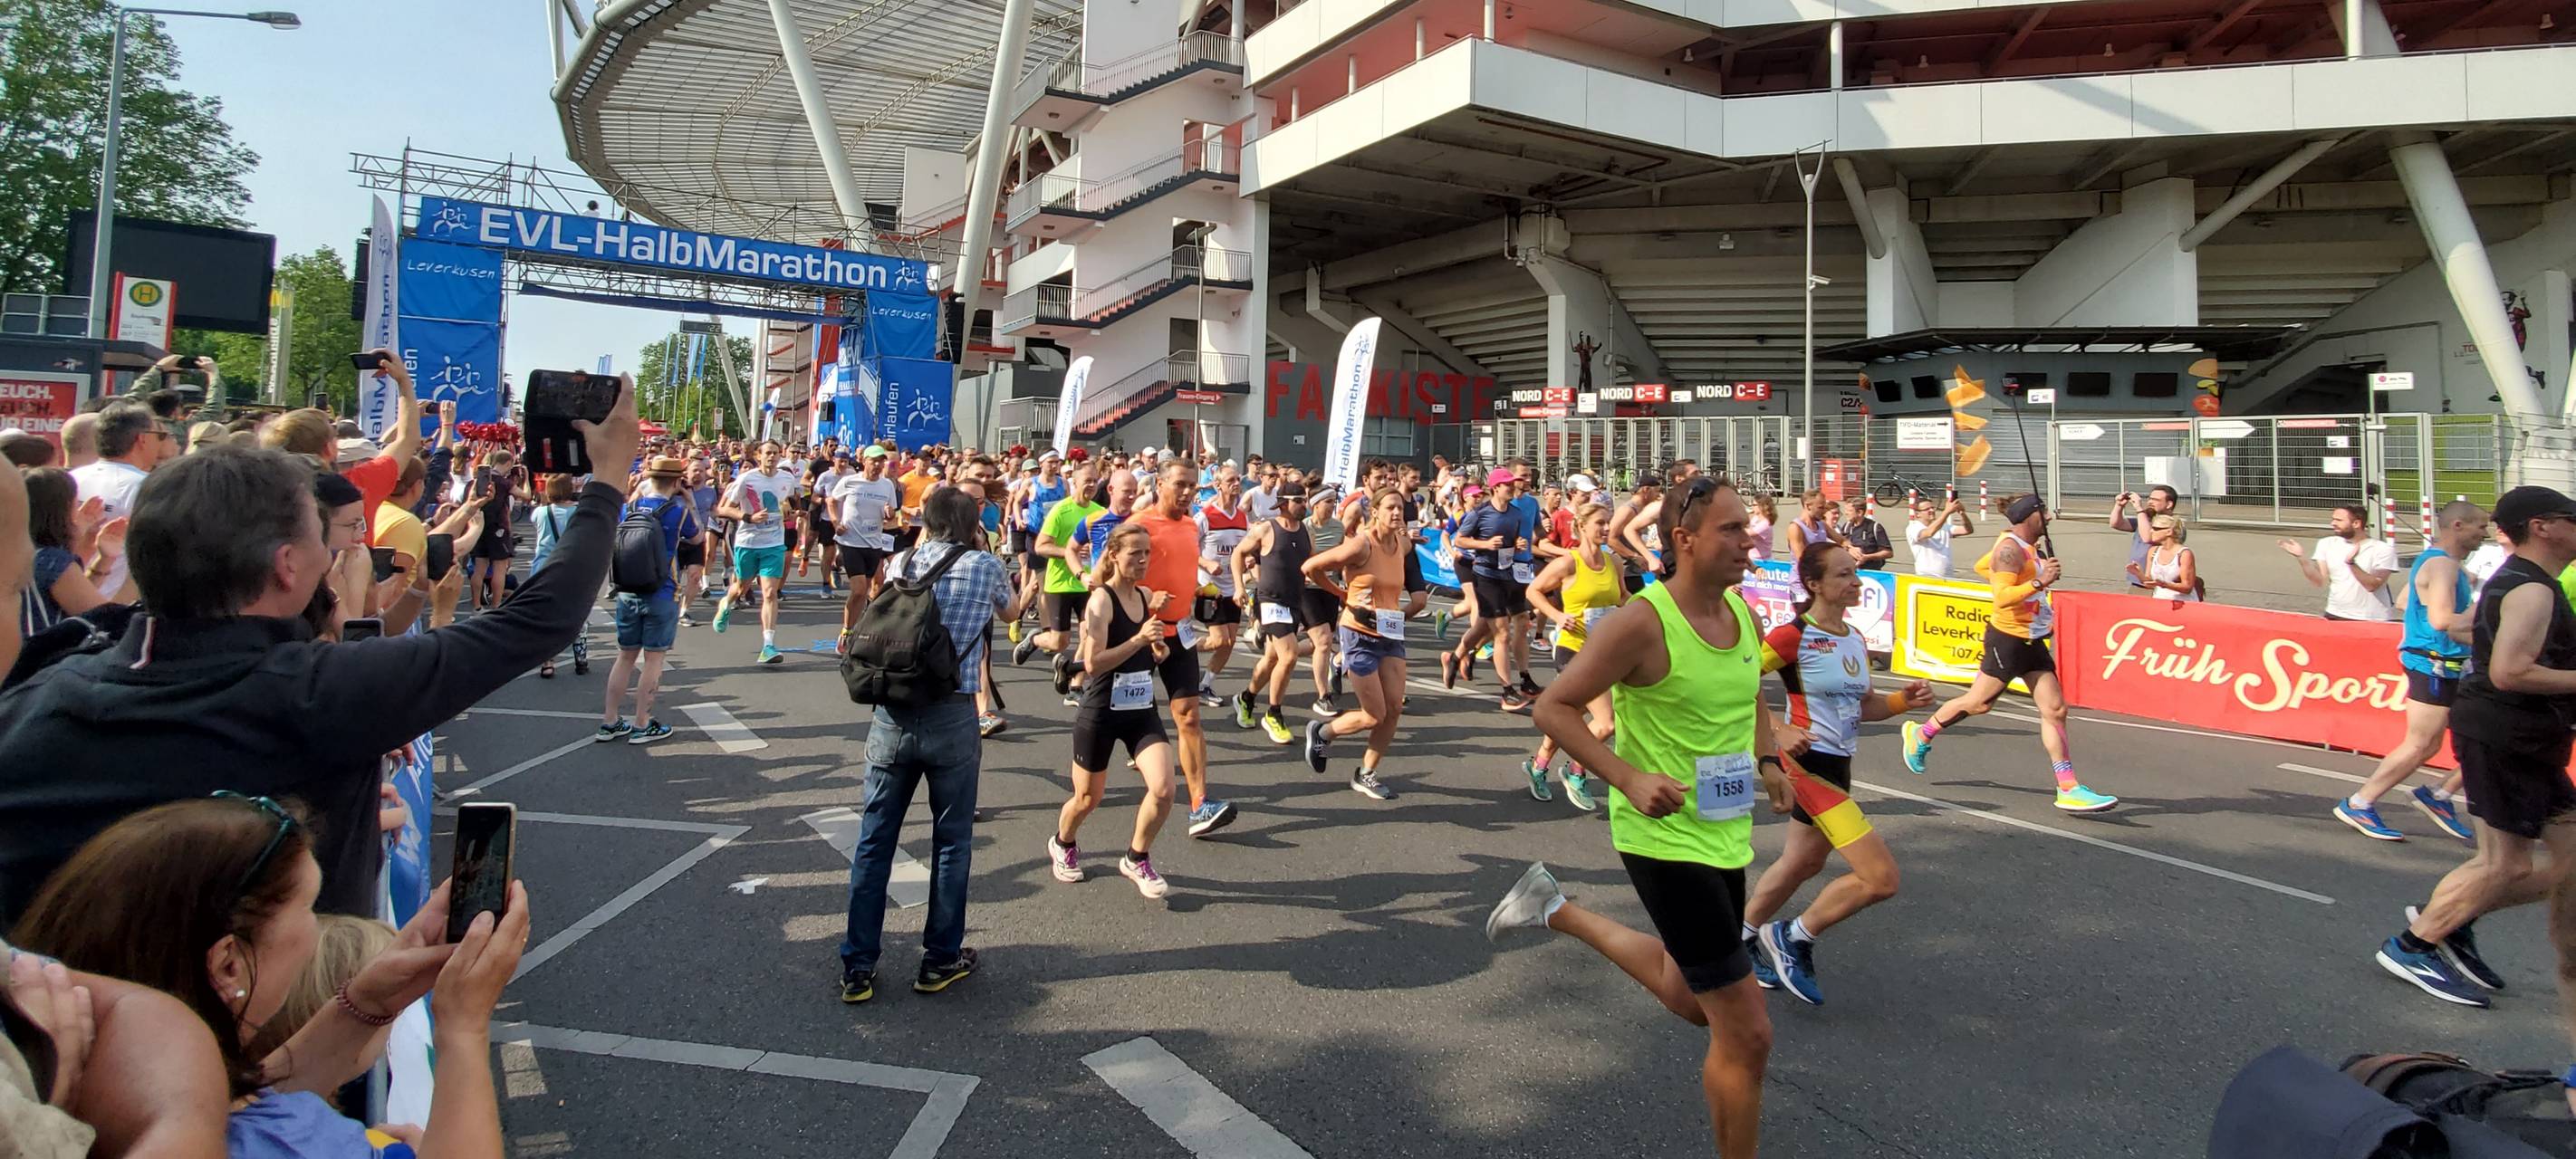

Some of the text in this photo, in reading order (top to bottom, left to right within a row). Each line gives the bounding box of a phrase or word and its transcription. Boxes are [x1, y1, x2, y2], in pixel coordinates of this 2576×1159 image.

[479, 206, 887, 289] EVL-HalbMarathon
[407, 259, 496, 280] Leverkusen
[872, 304, 932, 321] Leverkusen
[1267, 359, 1495, 427] FAKISTE
[1512, 389, 1542, 402] NORD
[1600, 388, 1632, 400] NORD
[1697, 385, 1732, 398] NORD
[1923, 621, 1985, 643] Leverku
[2101, 618, 2234, 685] Früh
[1124, 686, 1146, 698] 1472
[1714, 779, 1745, 798] 1558
